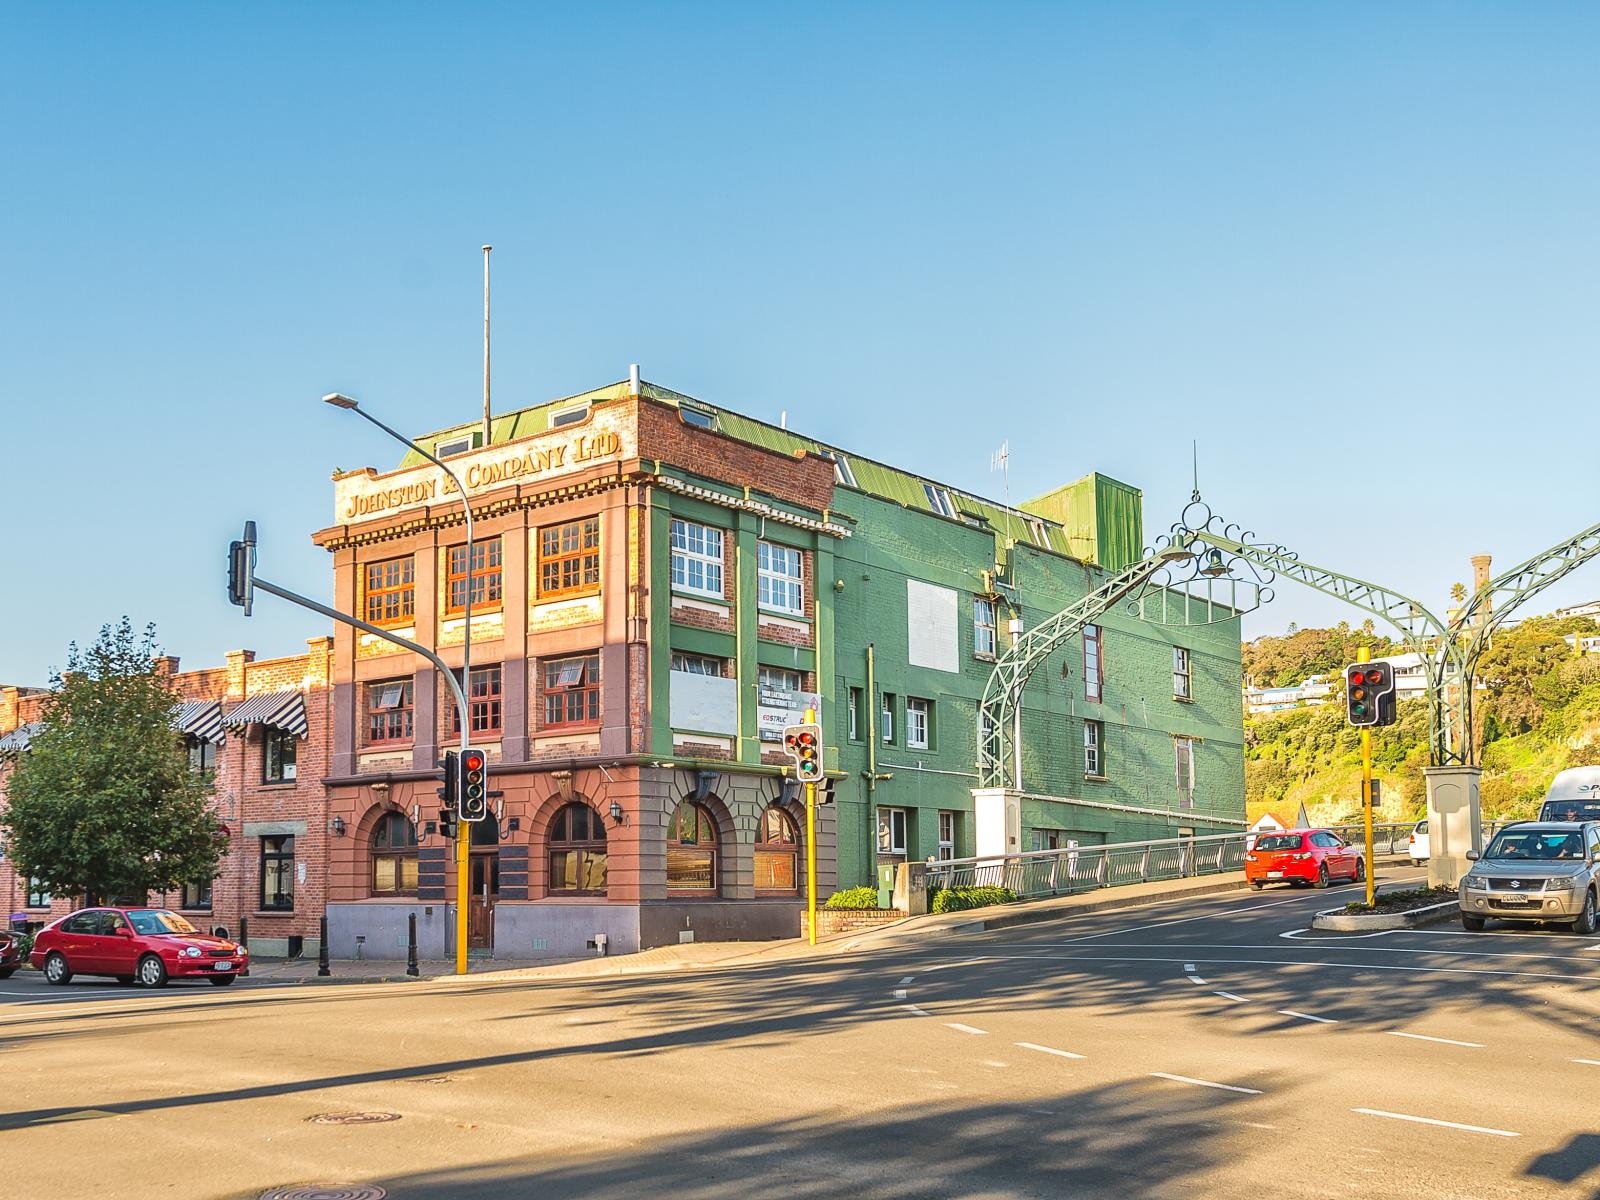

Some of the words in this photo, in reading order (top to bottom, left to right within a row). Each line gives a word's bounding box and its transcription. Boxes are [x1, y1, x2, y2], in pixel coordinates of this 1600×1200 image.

[346, 478, 437, 518] JOHNSTON
[441, 472, 460, 495] &
[465, 444, 568, 489] COMPANY
